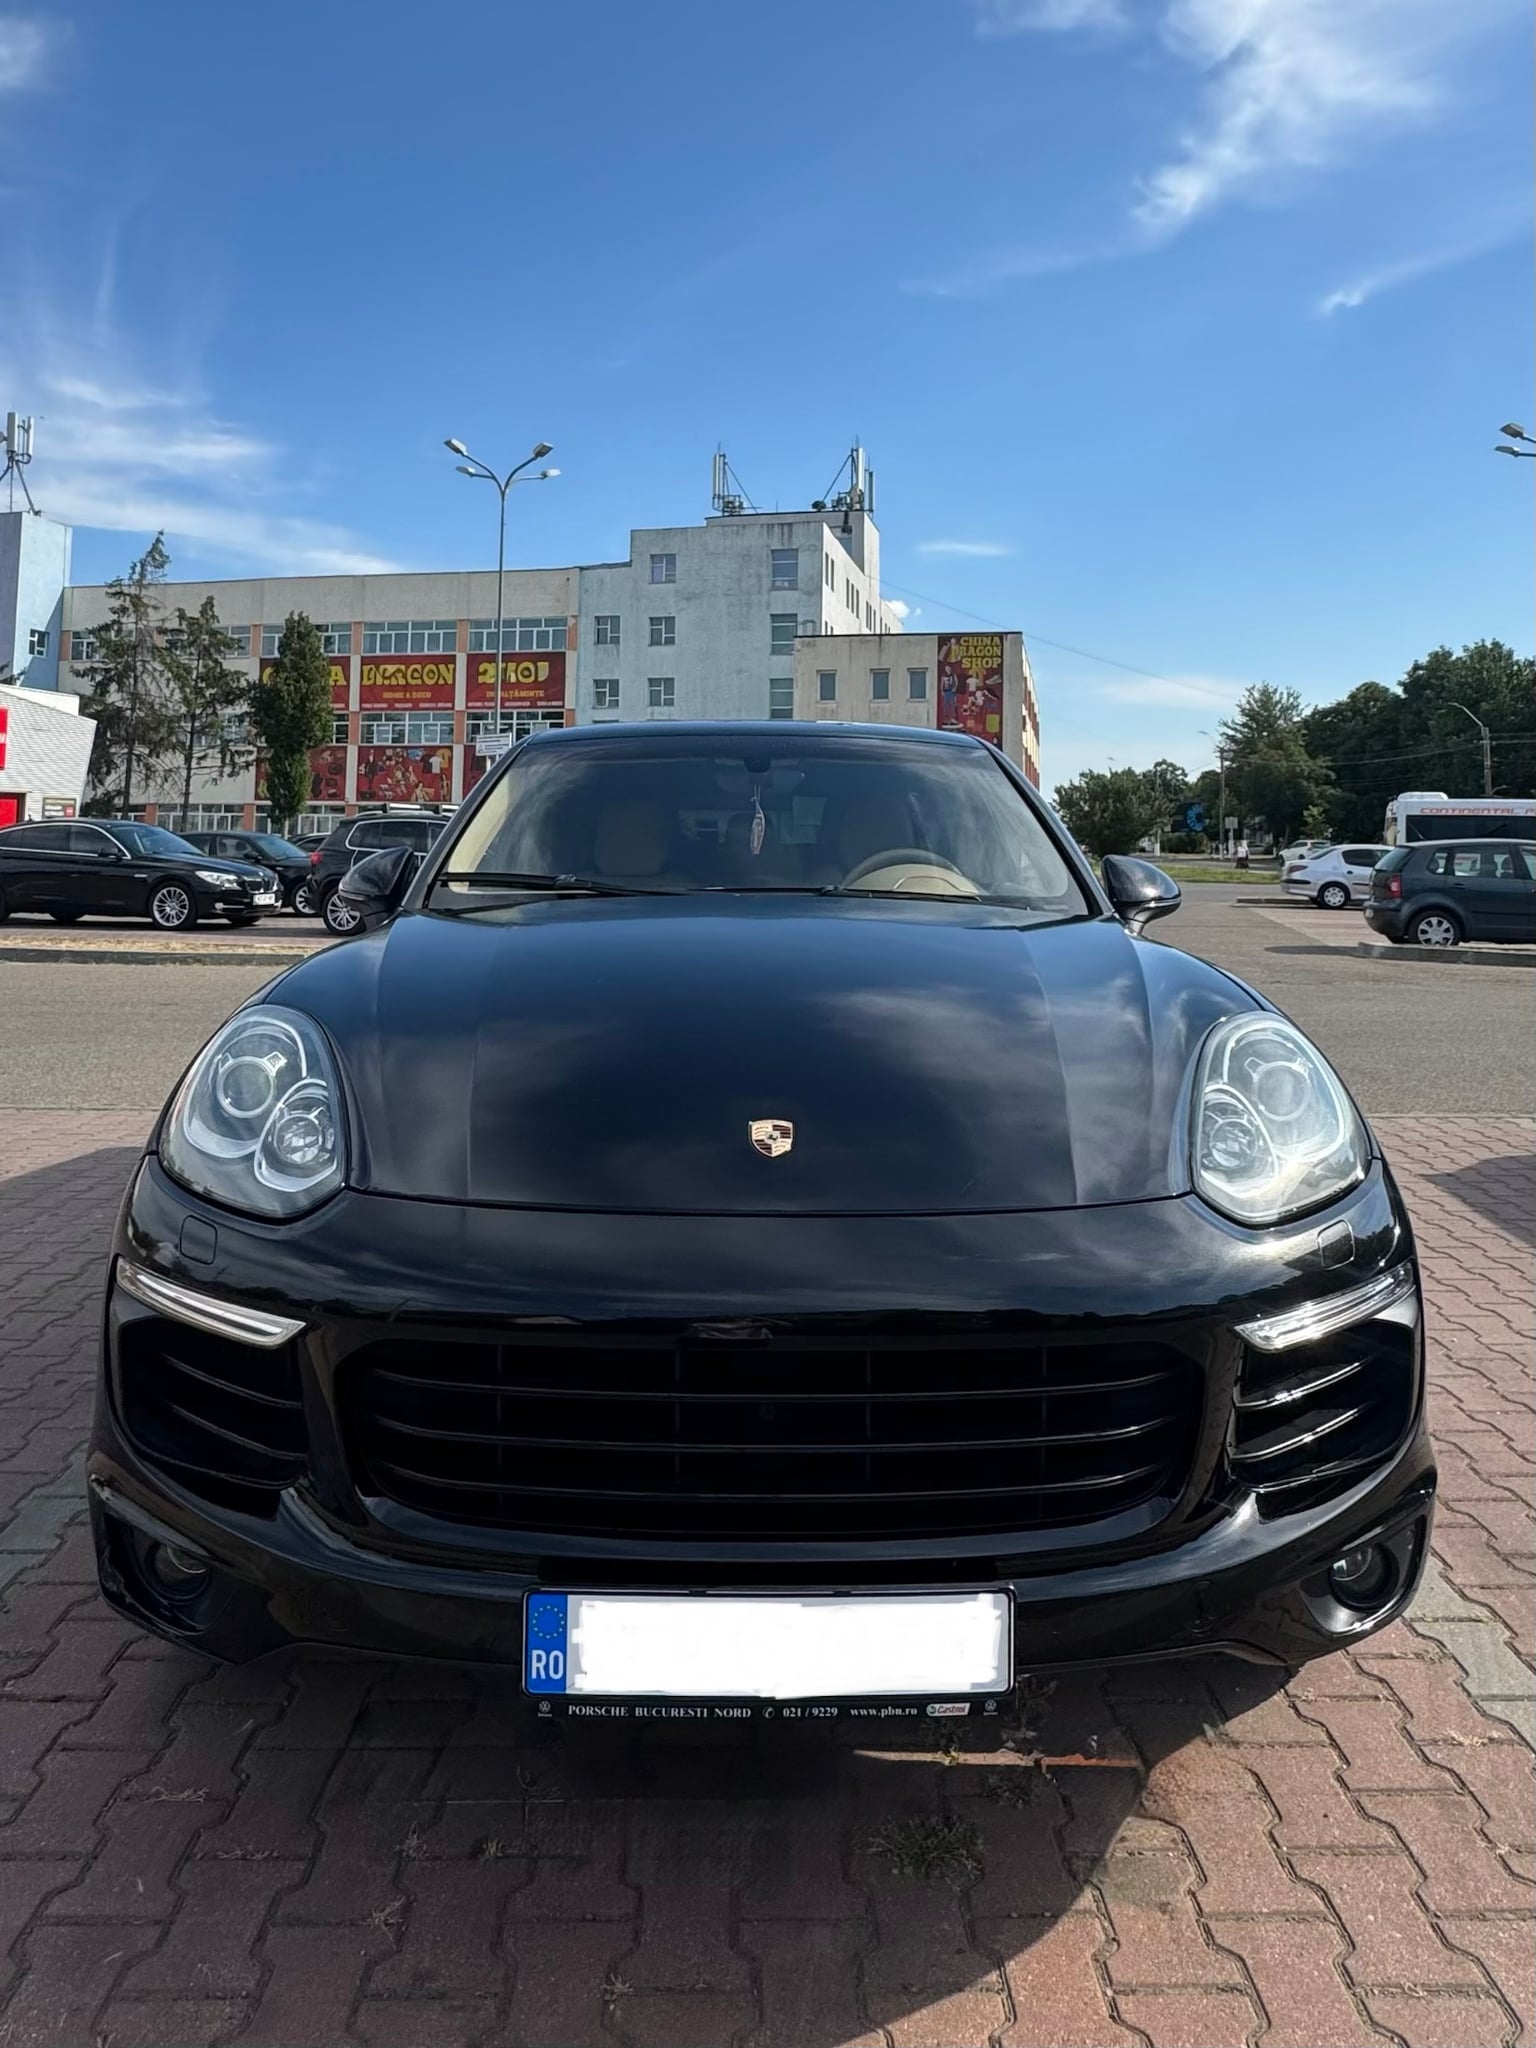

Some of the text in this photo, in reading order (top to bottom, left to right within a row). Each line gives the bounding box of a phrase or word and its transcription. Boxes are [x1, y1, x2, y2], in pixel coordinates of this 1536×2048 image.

[960, 636, 1001, 646] CHINA
[951, 646, 1002, 657] DRAGON
[961, 657, 1002, 668] SHOP
[531, 1649, 564, 1680] RO
[568, 1705, 629, 1717] PORSCHE
[635, 1706, 708, 1718] BUCURESTI
[714, 1707, 752, 1718] NORD
[850, 1705, 918, 1718] www.pbn.ro
[937, 1704, 967, 1713] Castrol
